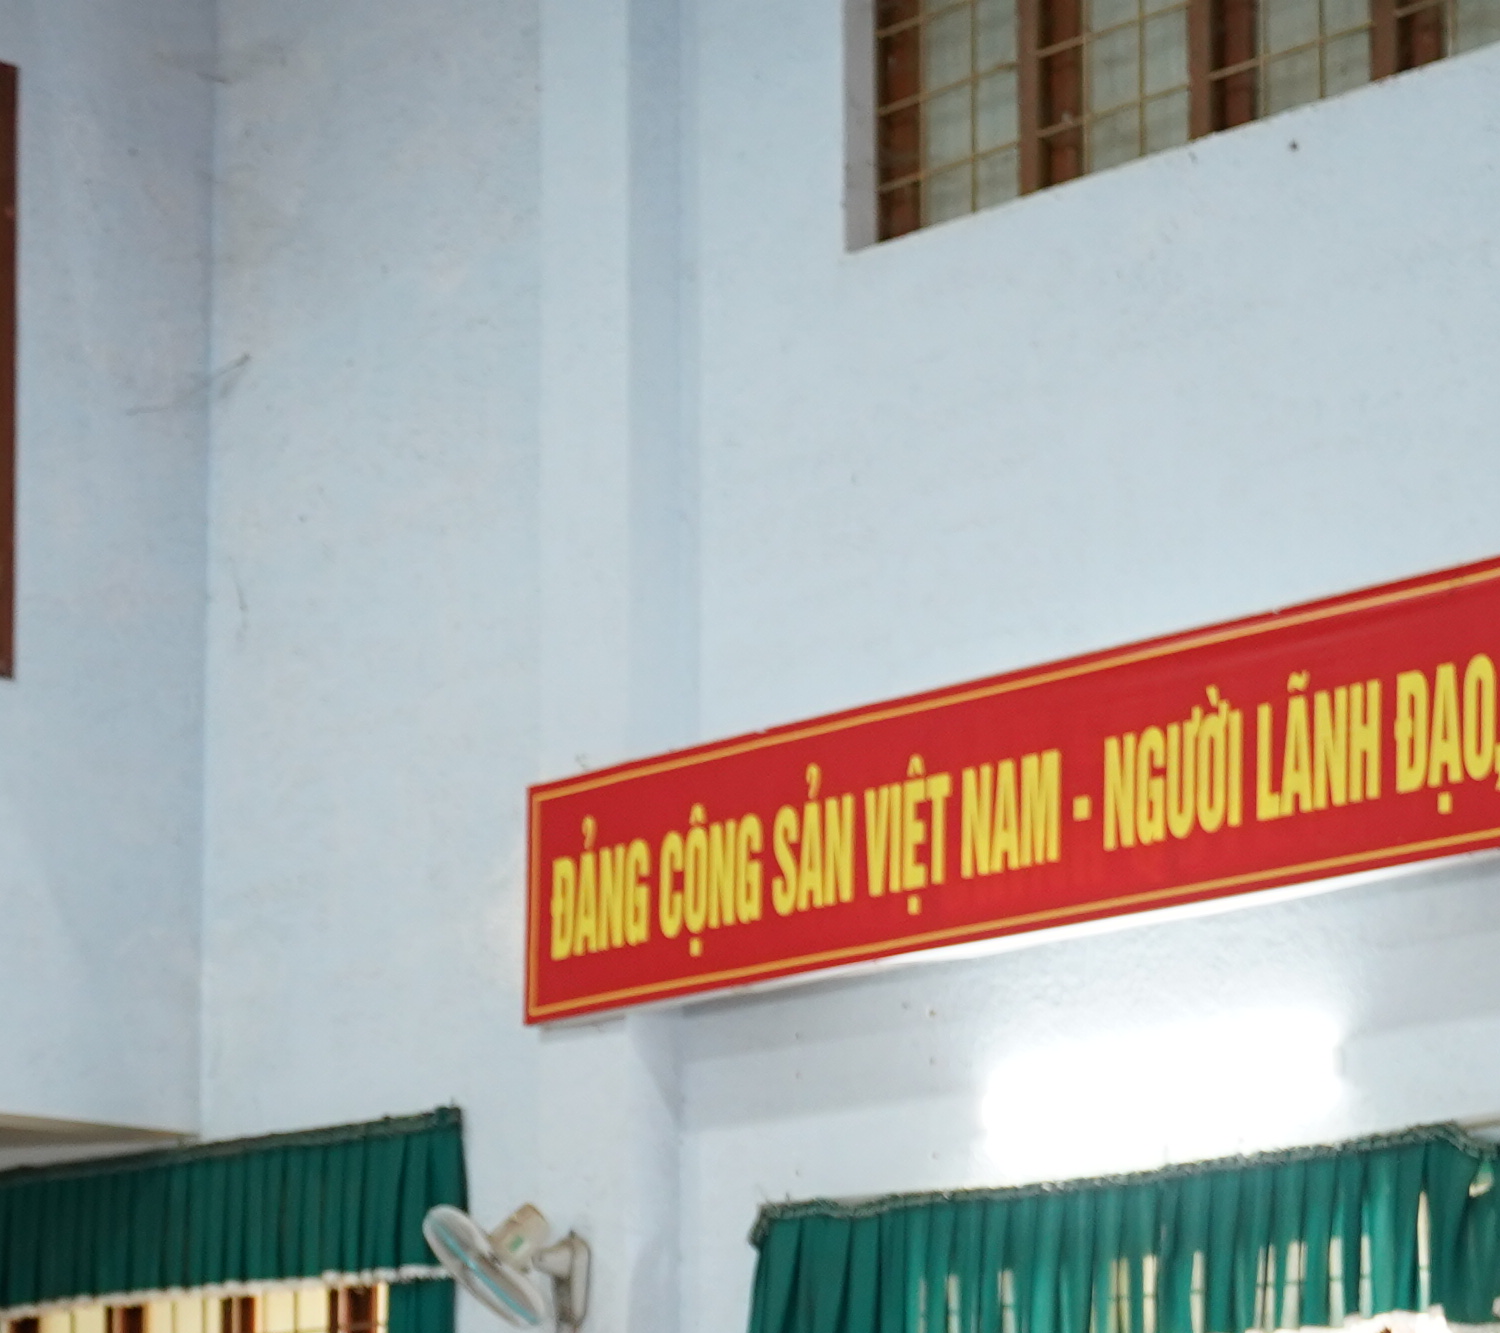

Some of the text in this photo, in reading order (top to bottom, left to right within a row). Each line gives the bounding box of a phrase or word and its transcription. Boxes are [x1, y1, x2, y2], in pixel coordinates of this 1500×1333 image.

[551, 817, 650, 960] ĐẢNG
[659, 805, 762, 956] CỘNG
[772, 764, 854, 915] SẢN
[865, 755, 951, 914] VIỆT
[961, 750, 1060, 878] NAM
[1104, 686, 1242, 850] NGƯỜI
[1257, 672, 1381, 821] LÃNH
